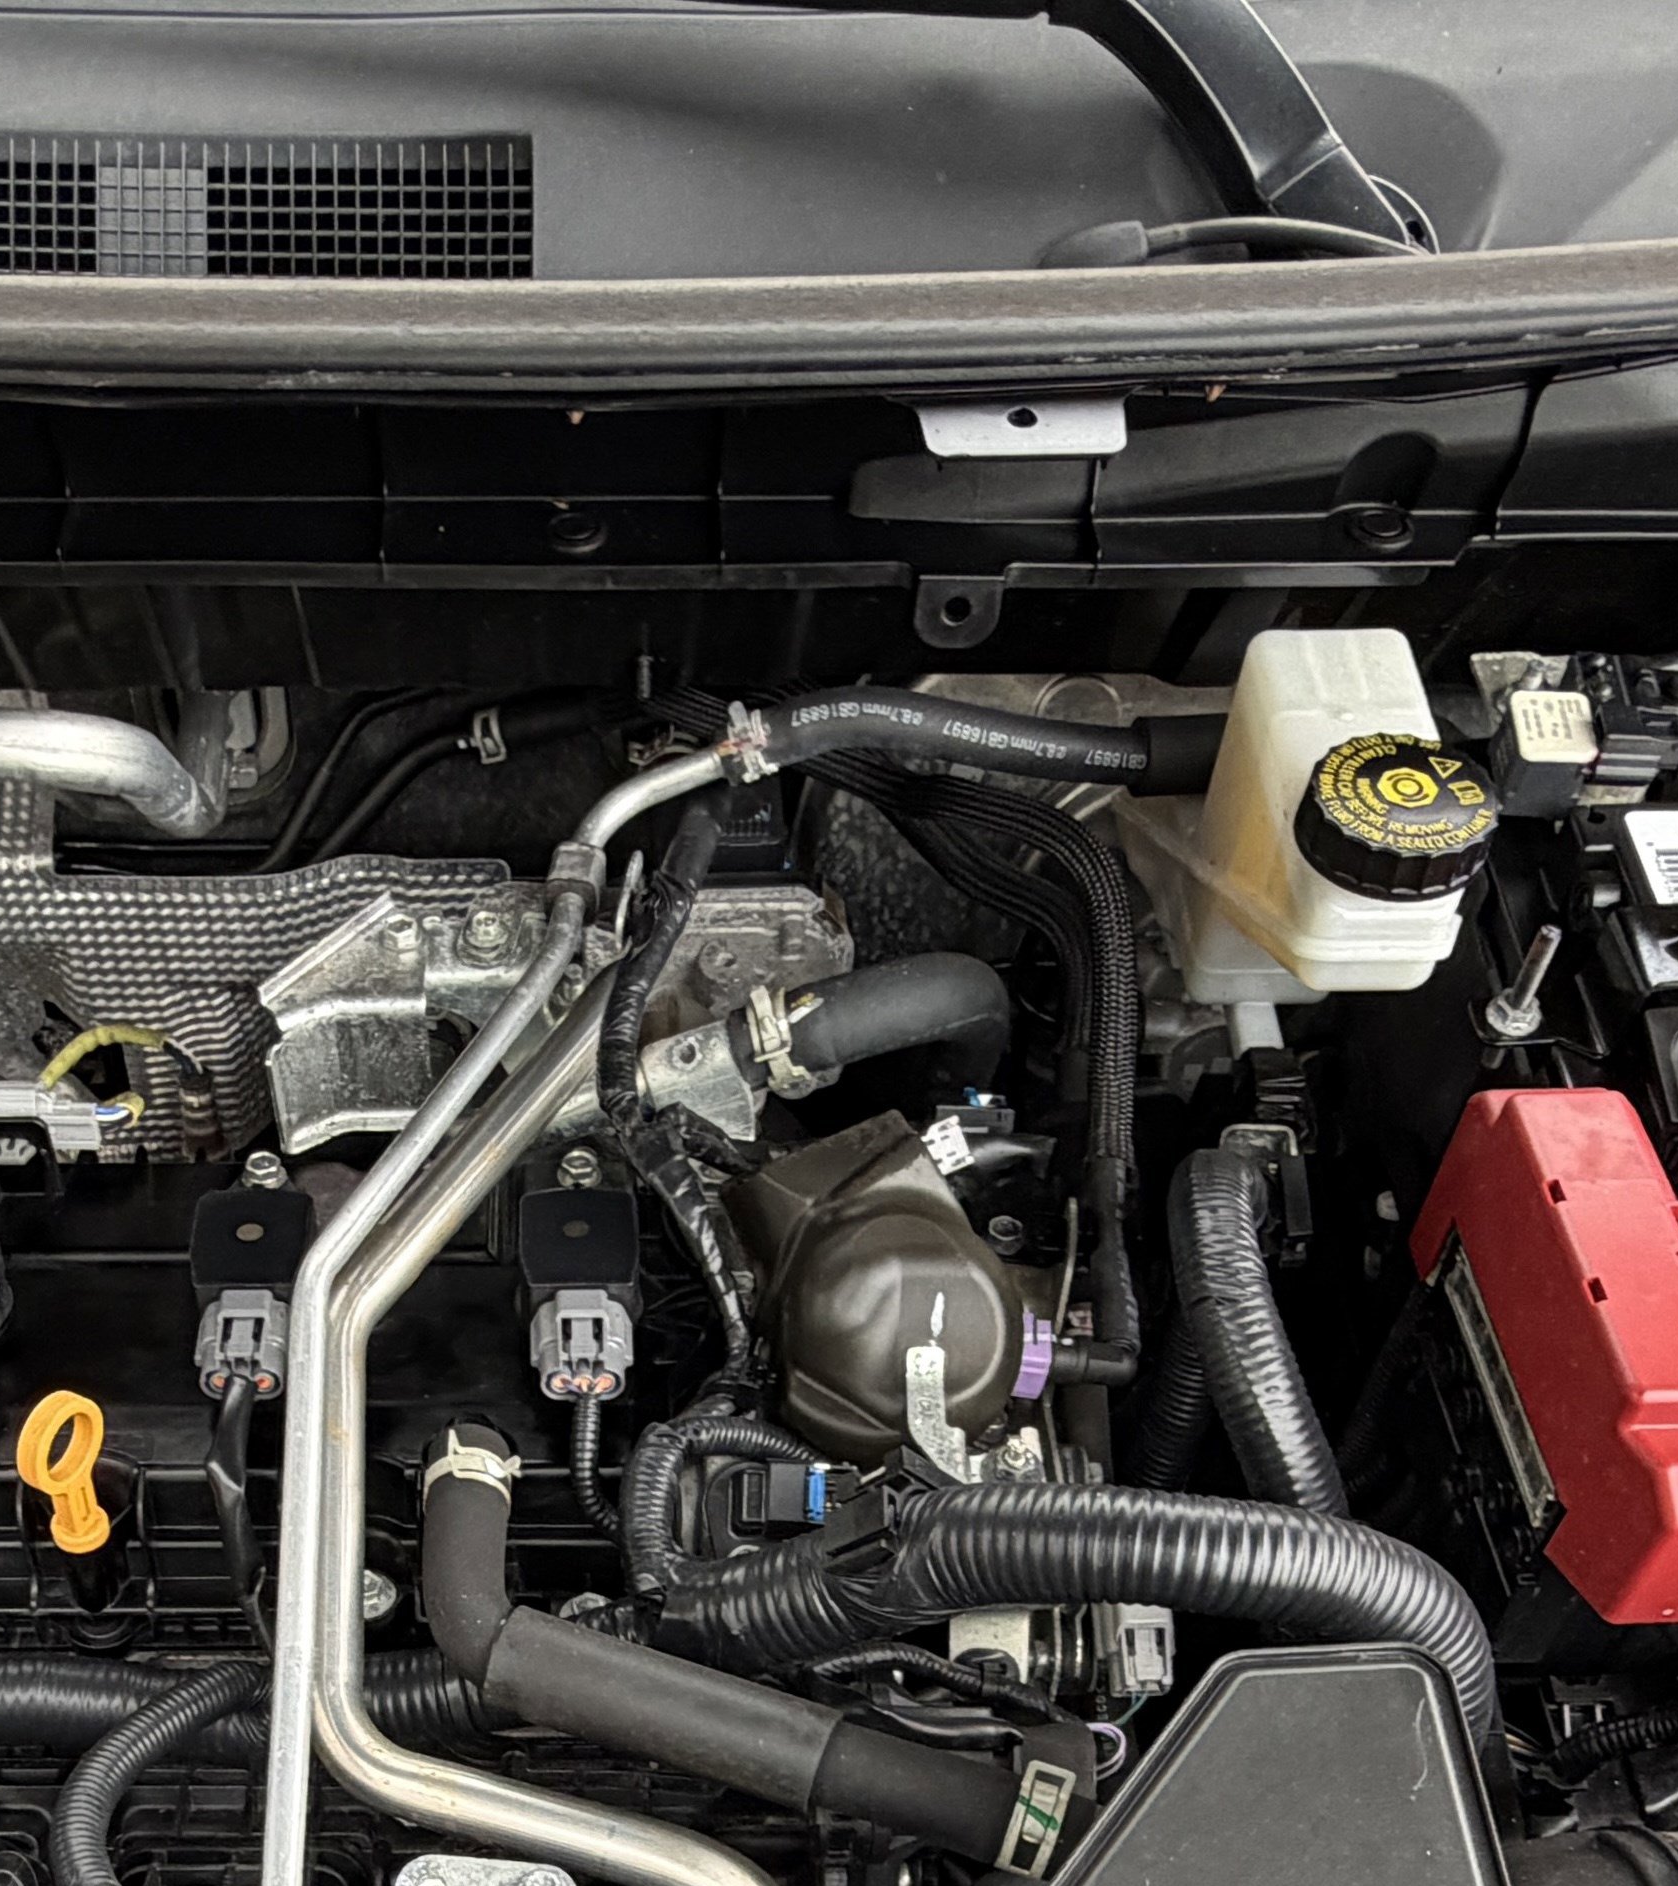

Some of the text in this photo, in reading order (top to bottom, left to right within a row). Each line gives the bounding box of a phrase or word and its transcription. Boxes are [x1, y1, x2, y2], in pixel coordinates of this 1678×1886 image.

[791, 702, 860, 728] GB16897
[942, 718, 1011, 750] GB16897
[1350, 820, 1383, 843] FROM
[1397, 835, 1445, 850] SEALED
[1443, 809, 1493, 847] CONTAINER
